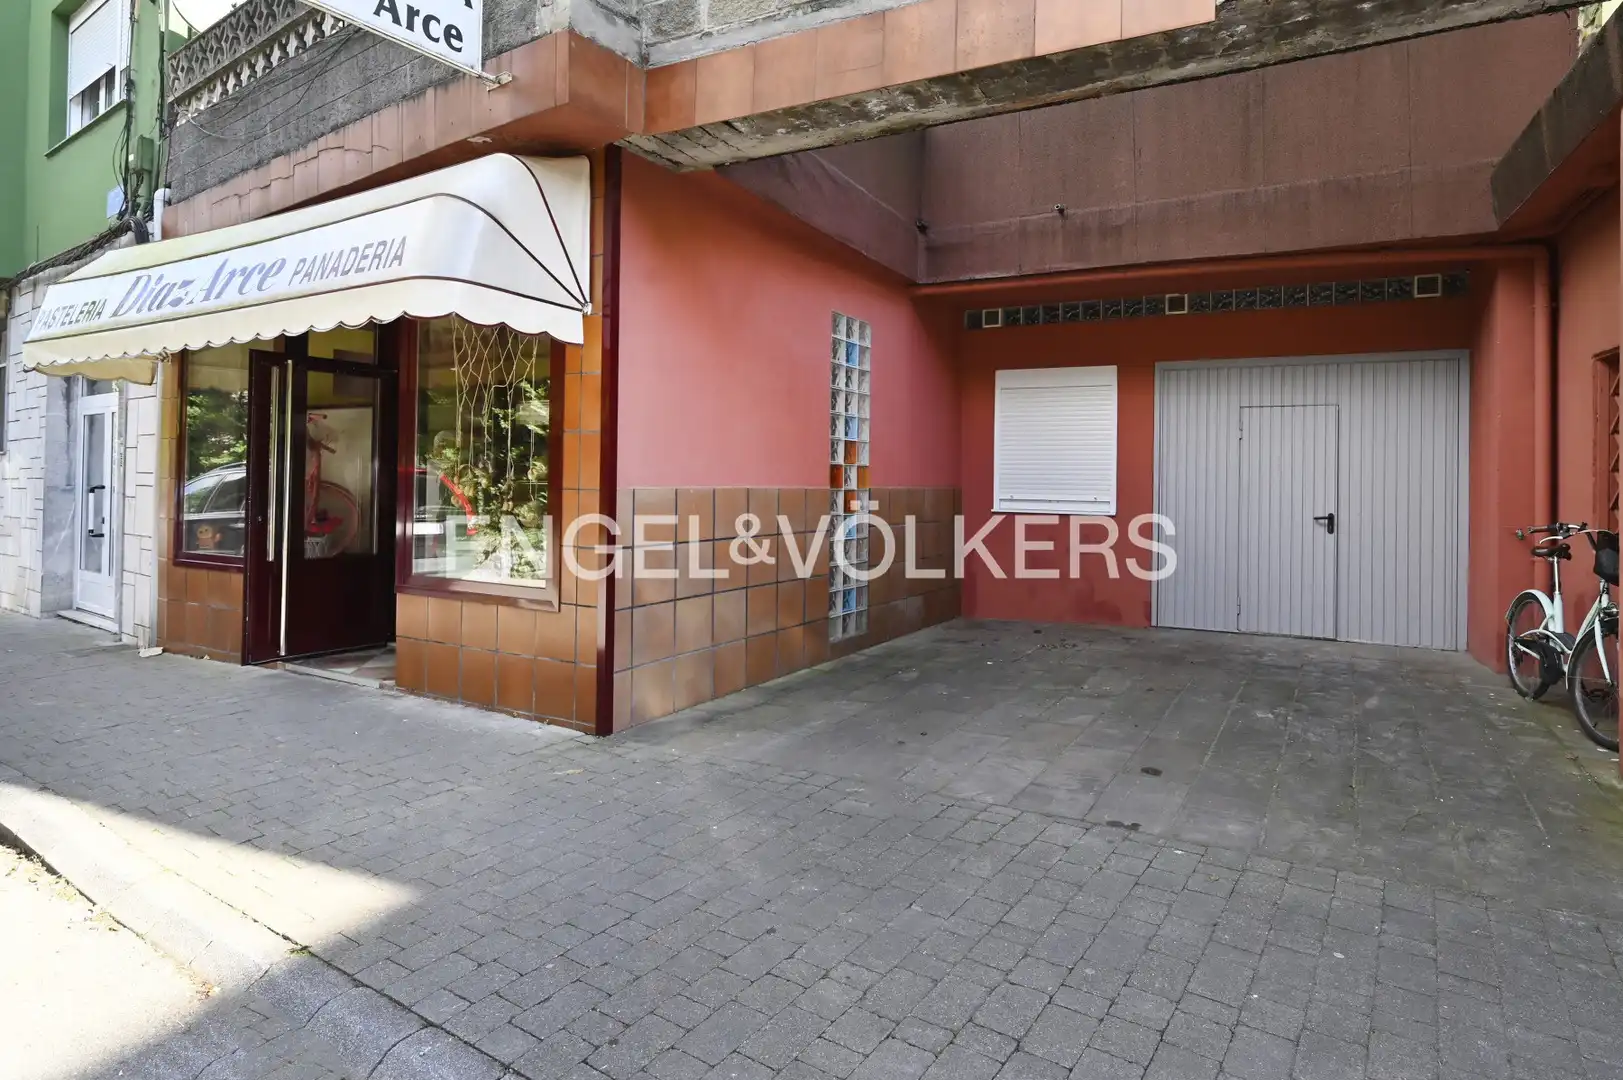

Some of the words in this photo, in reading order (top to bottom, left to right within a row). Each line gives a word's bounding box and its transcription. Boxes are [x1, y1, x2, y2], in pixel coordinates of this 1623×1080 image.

[373, 0, 463, 53] Arce
[36, 298, 107, 331] PASTELERIA
[186, 257, 287, 304] Arce
[287, 235, 407, 286] PANADERIA
